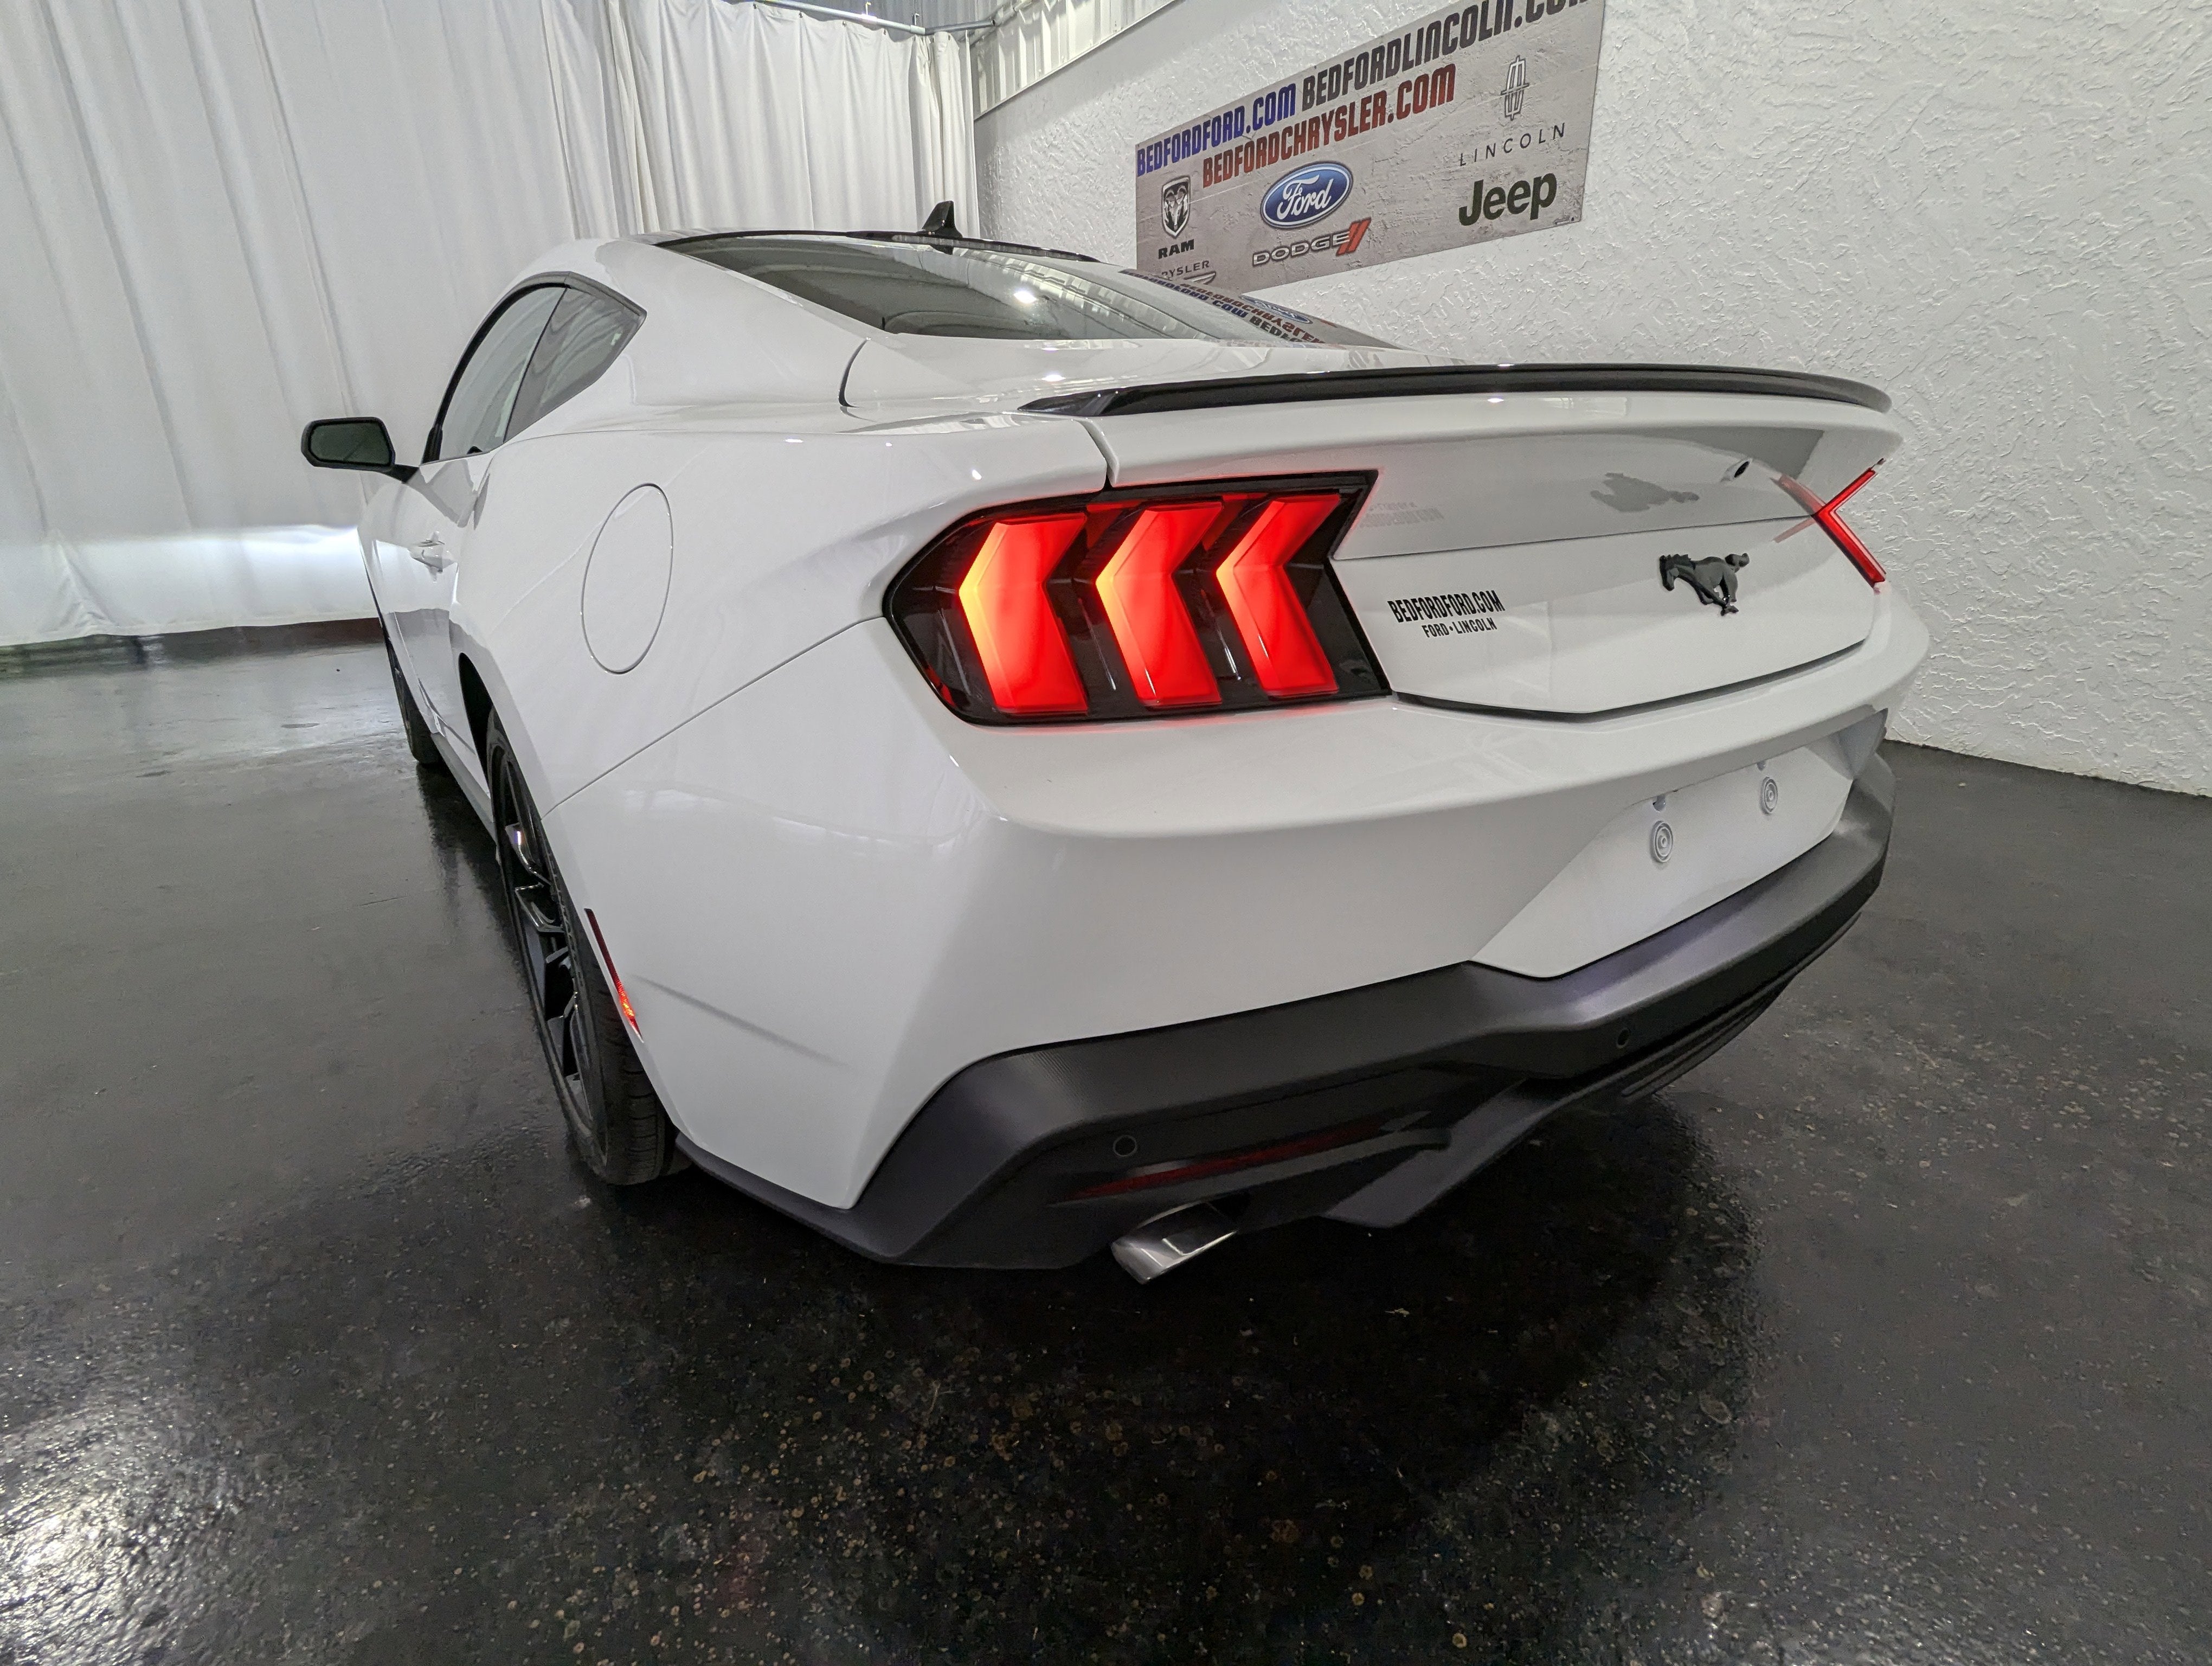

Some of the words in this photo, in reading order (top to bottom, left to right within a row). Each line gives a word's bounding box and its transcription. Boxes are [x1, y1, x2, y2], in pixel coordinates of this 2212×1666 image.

[1137, 83, 1296, 177] BEDFORDFORD.COM
[1302, 0, 1587, 112] BEDFORDLINCOLN.
[1203, 63, 1456, 188] BEDFORDCHRYSLER.COM
[1459, 123, 1565, 166] LINCOLN
[1277, 174, 1334, 220] Ford
[1458, 172, 1557, 226] Jeep
[1158, 239, 1194, 259] RAM
[1252, 230, 1351, 266] DODGE
[1161, 260, 1210, 278] RYSLER
[1387, 590, 1506, 623] BEDFORDFORD.COM
[1422, 623, 1450, 638] FORD
[1452, 617, 1497, 635] LINCOLN
